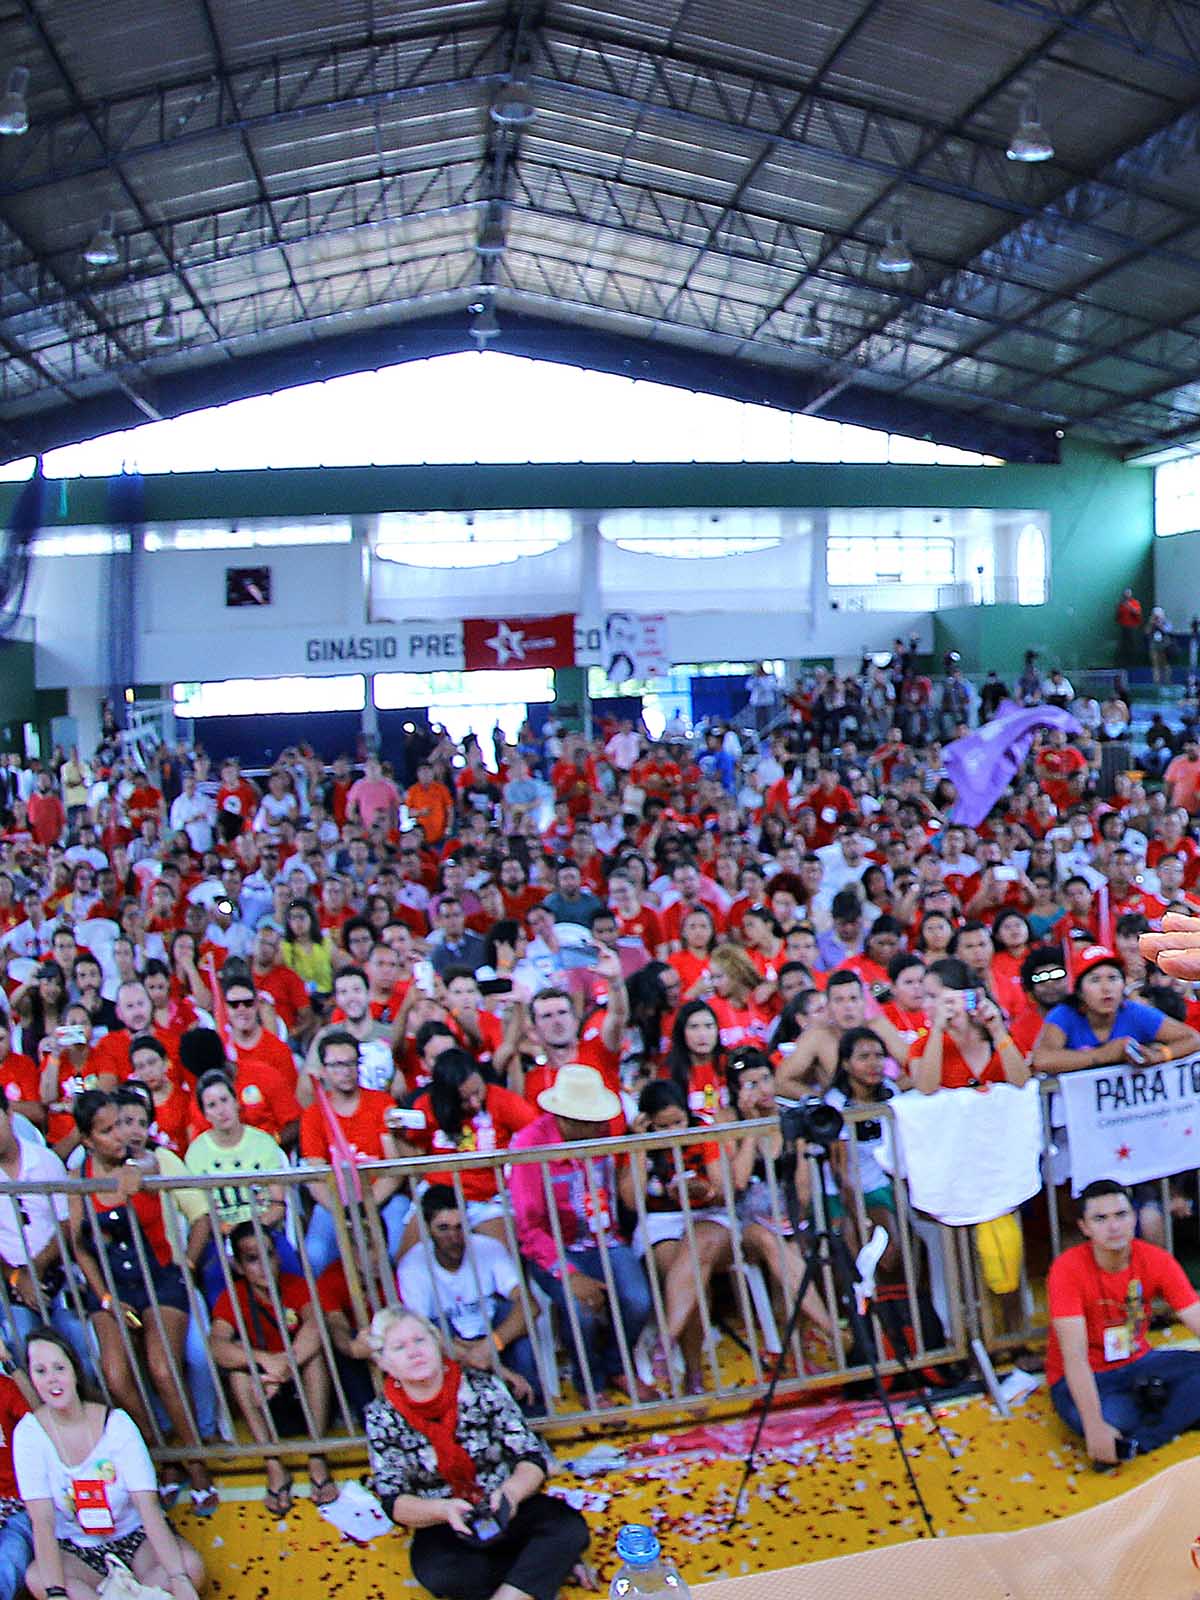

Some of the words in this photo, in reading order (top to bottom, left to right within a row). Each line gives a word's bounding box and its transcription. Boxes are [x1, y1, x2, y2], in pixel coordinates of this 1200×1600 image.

[306, 635, 397, 662] GINÁSIO
[408, 632, 465, 658] PRE
[1095, 1070, 1167, 1112] PARA
